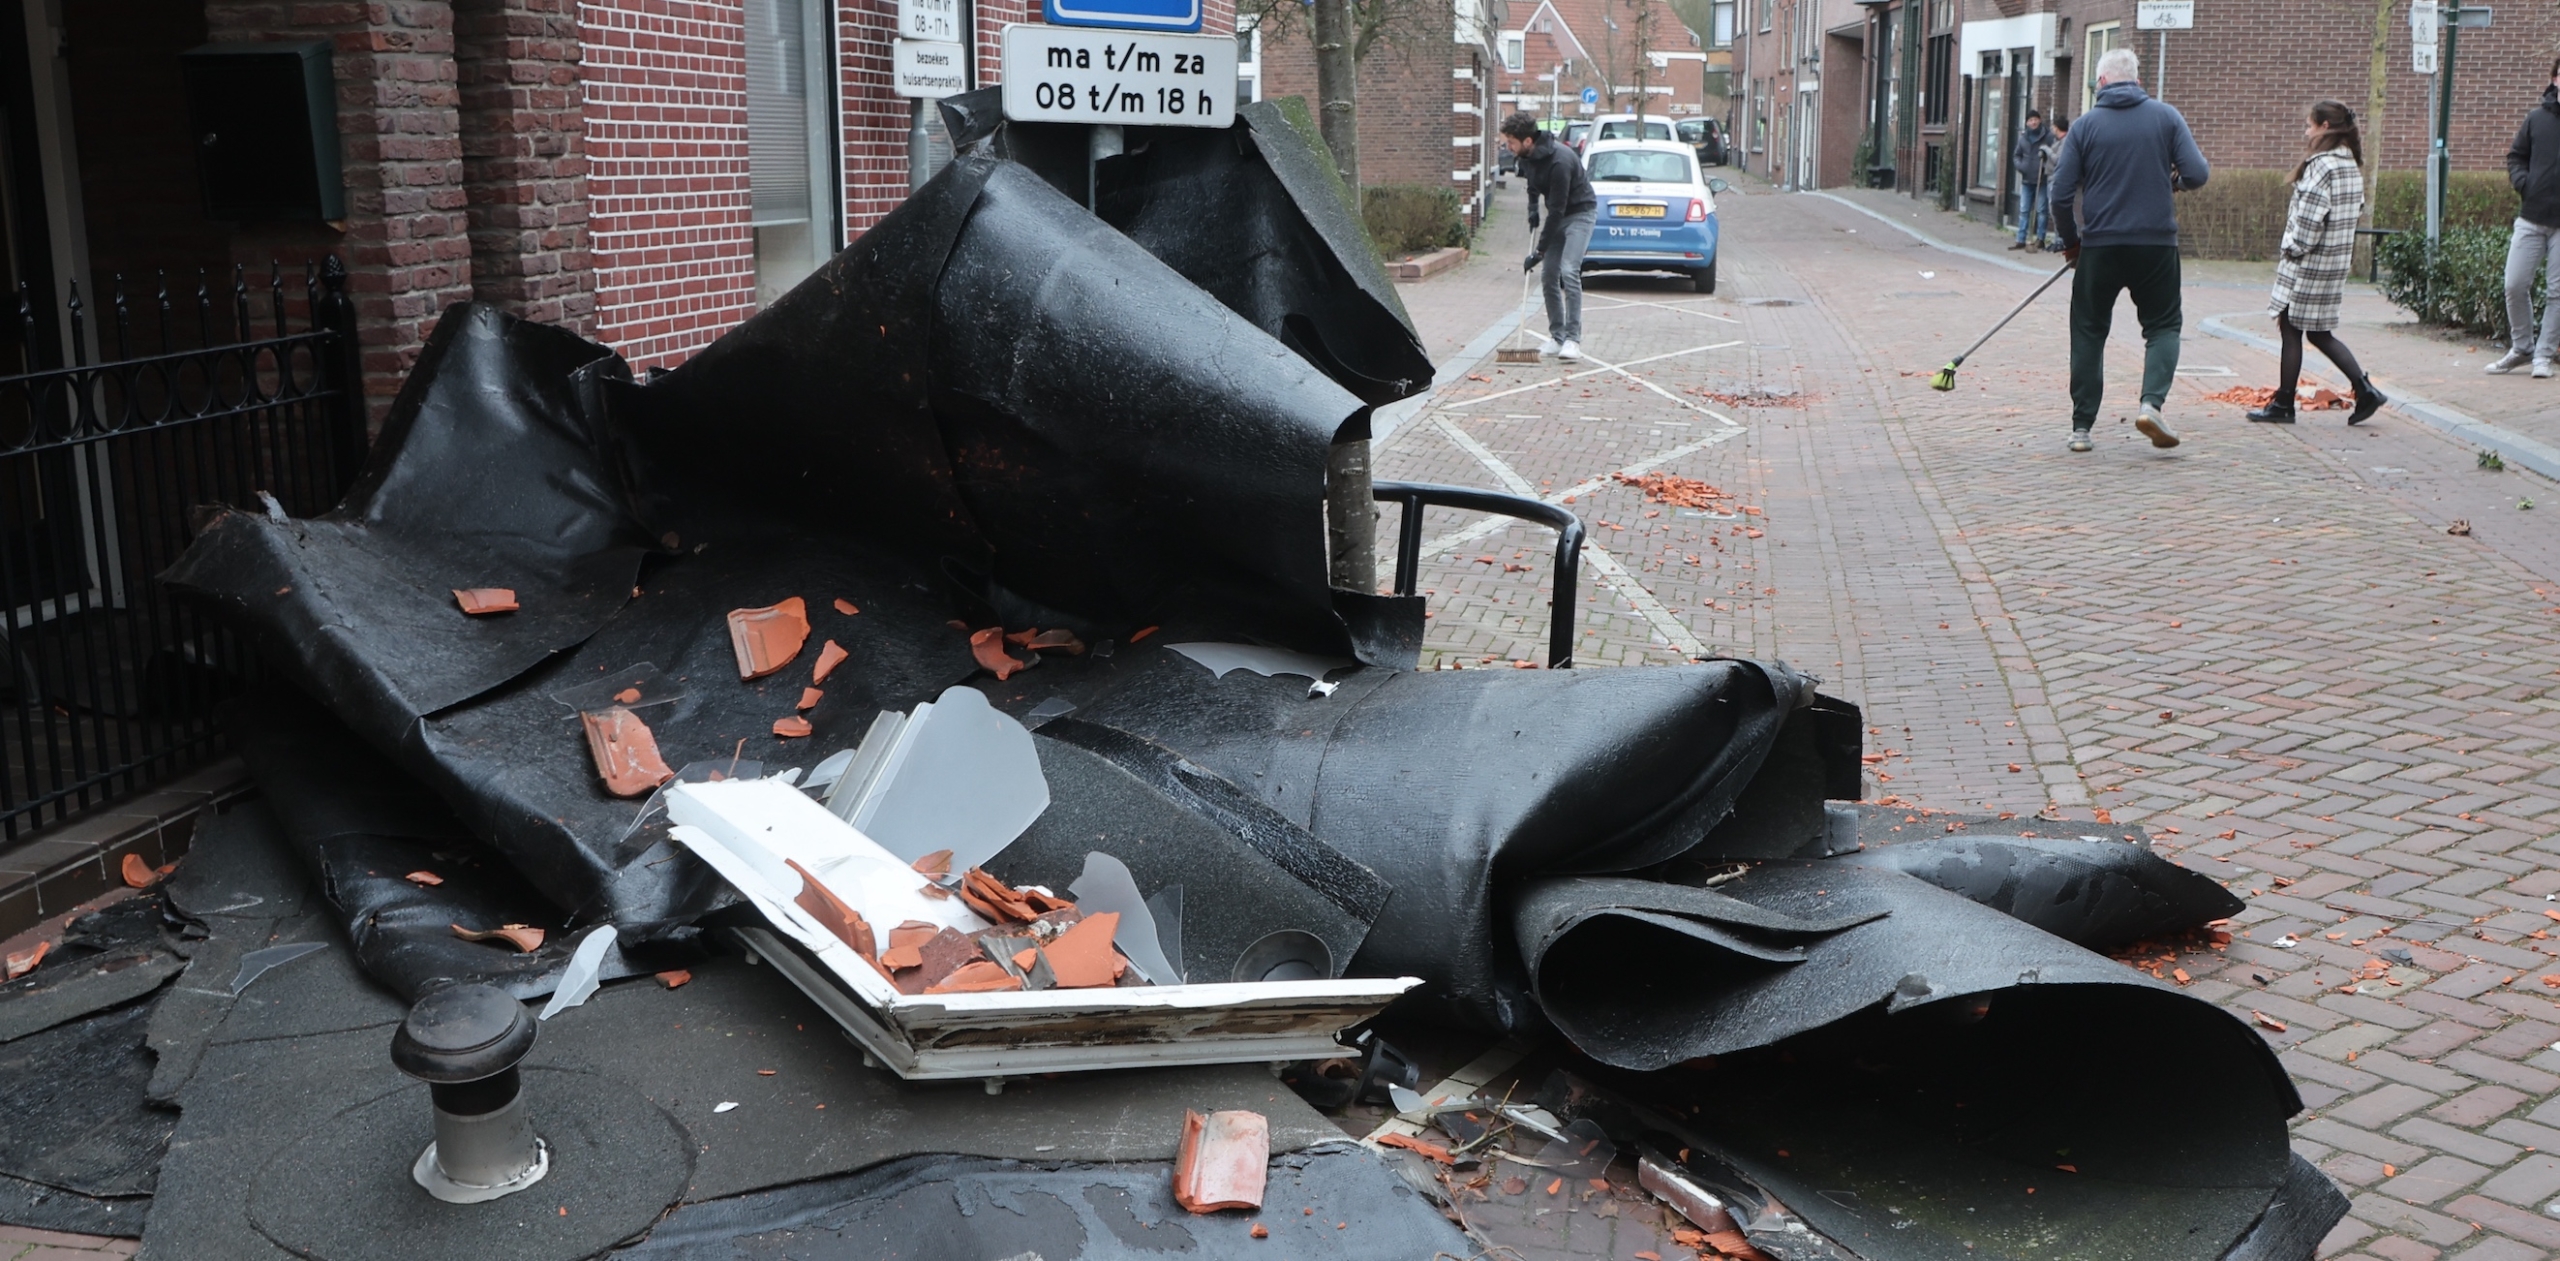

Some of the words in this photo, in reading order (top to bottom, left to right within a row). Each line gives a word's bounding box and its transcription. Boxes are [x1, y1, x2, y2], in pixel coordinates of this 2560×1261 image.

[943, 0, 951, 13] vr
[915, 14, 926, 33] 08
[934, 17, 942, 35] 17
[944, 18, 950, 37] h
[916, 50, 949, 66] bezoekers
[1047, 46, 1090, 69] ma
[1104, 42, 1160, 72] t/m
[1173, 53, 1205, 75] za
[902, 72, 963, 93] huisartsenpraktijk
[1035, 82, 1076, 110] 08
[1088, 83, 1144, 113] t/m
[1157, 87, 1185, 115] 18
[1198, 89, 1213, 116] h
